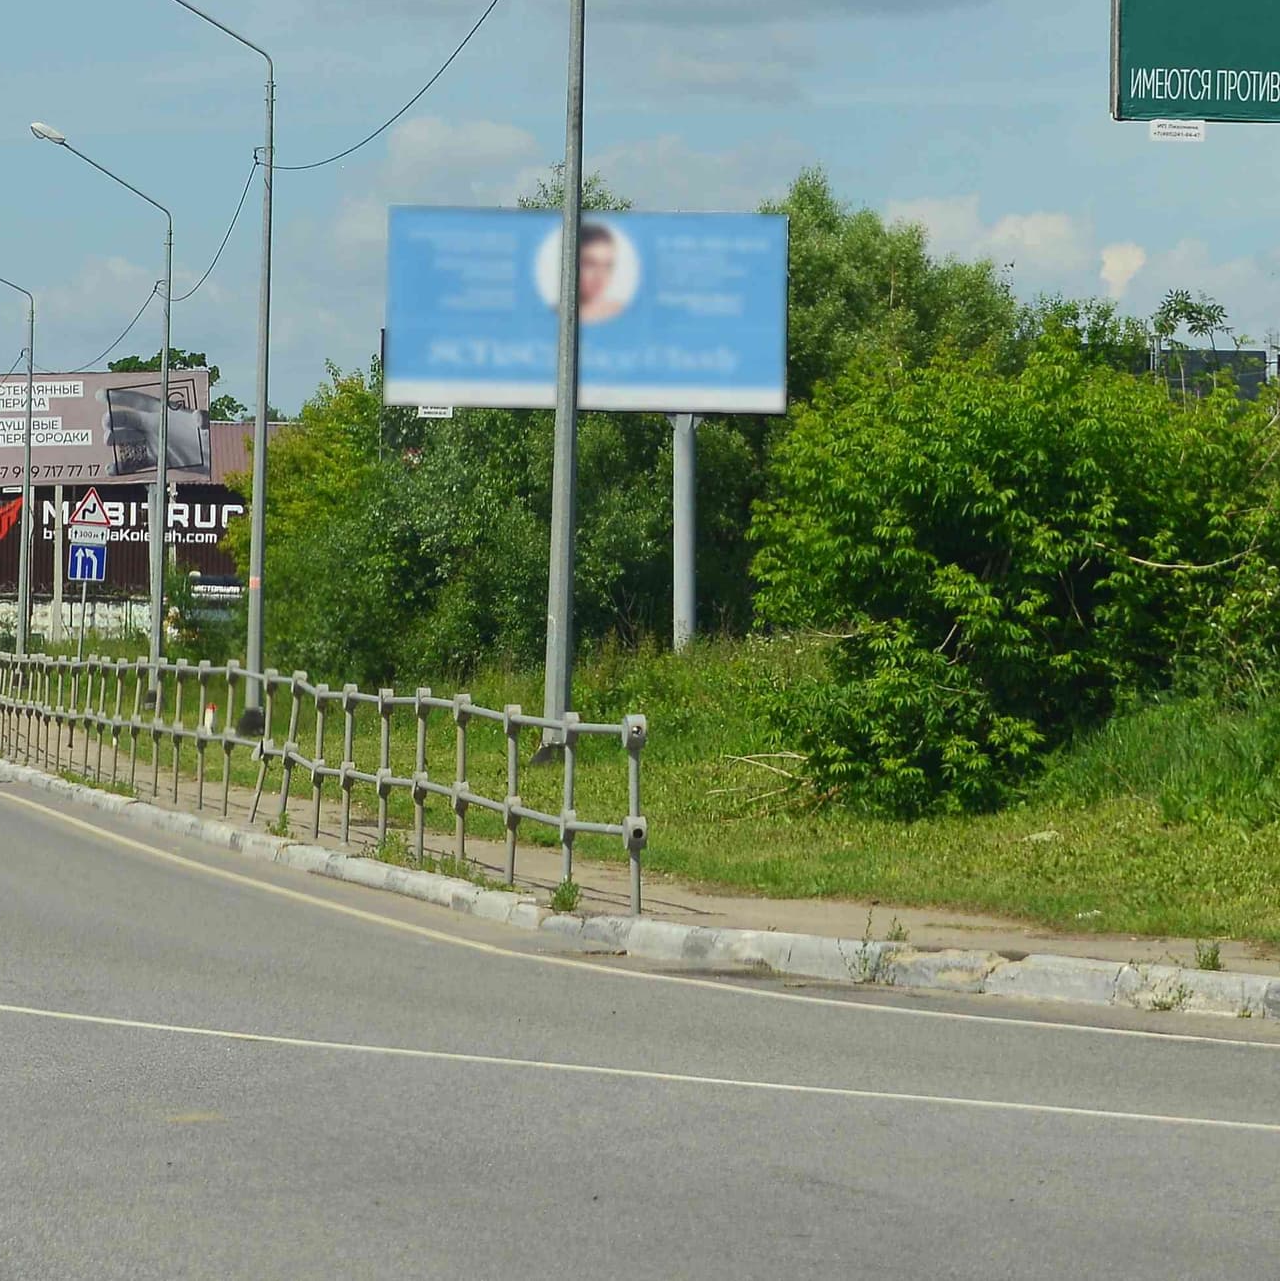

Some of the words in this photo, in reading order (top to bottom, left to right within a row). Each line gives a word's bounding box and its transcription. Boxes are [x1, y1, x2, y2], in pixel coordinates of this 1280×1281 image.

[1130, 67, 1212, 100] ИМЕЮТСЯ
[43, 465, 64, 478] 717
[68, 464, 83, 477] 77
[87, 464, 100, 477] 17
[43, 501, 244, 529] MBIRUC
